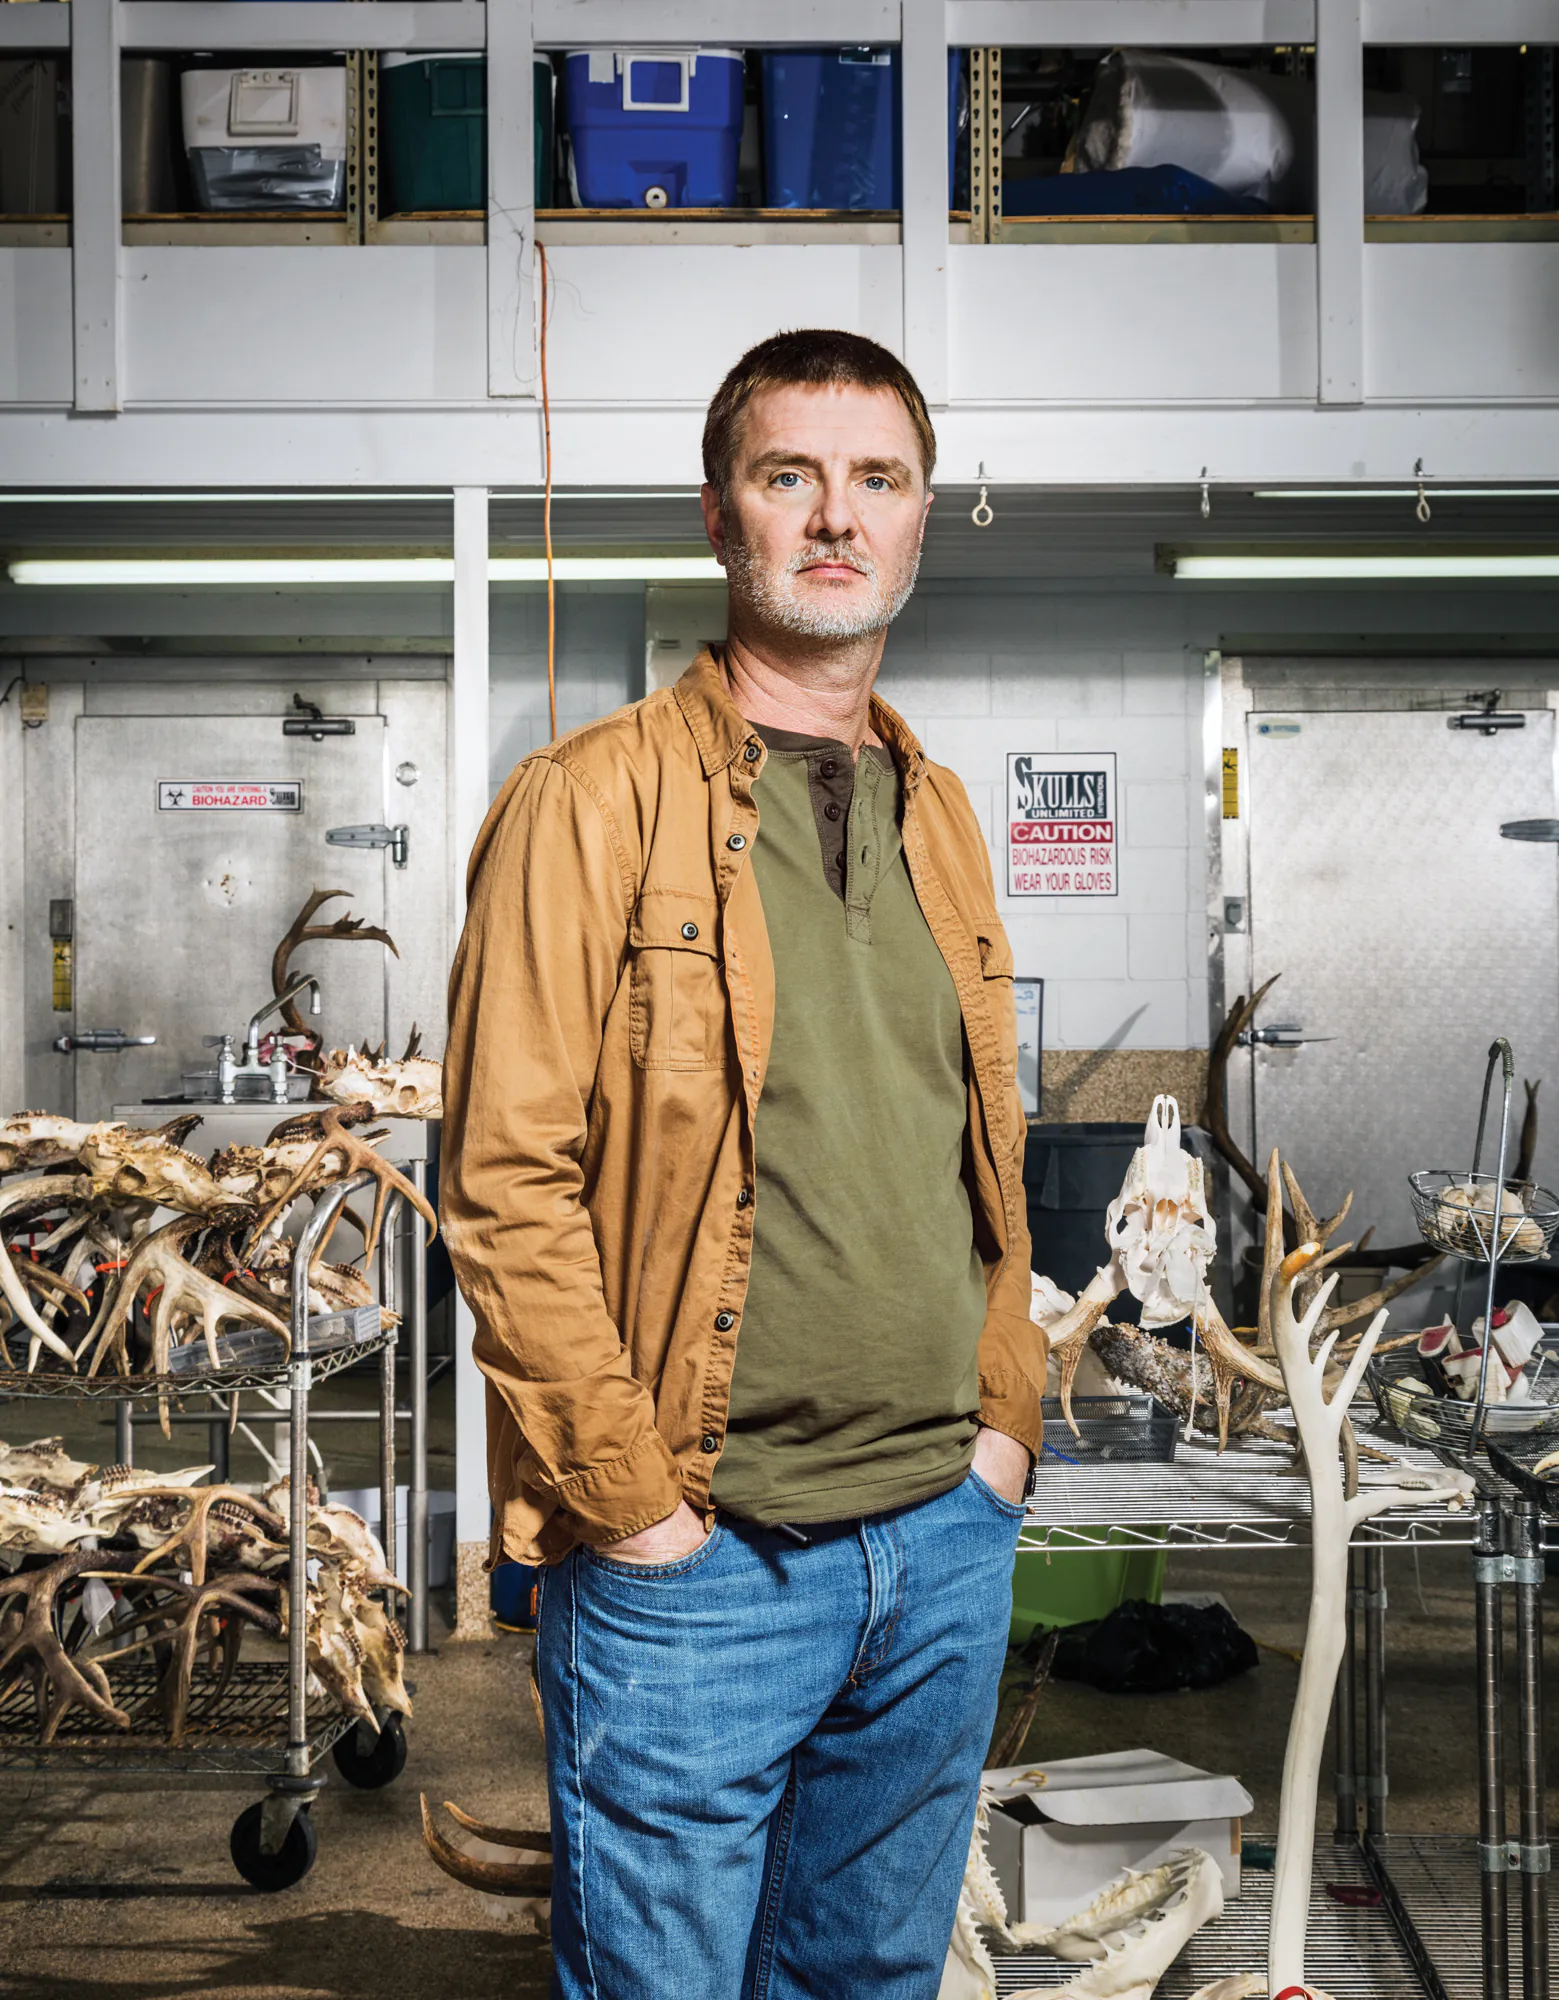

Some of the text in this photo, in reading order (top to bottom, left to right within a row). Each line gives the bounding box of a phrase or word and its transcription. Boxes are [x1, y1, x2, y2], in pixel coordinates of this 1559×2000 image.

[1014, 756, 1095, 811] SKULLS
[192, 795, 267, 806] BIOHAZARD
[1031, 809, 1095, 818] UNLIMITED
[1013, 824, 1112, 841] CAUTION
[1012, 847, 1112, 866] BIOHAZARDOUS RISK
[1014, 872, 1112, 891] WEAR YOUR GLOVES
